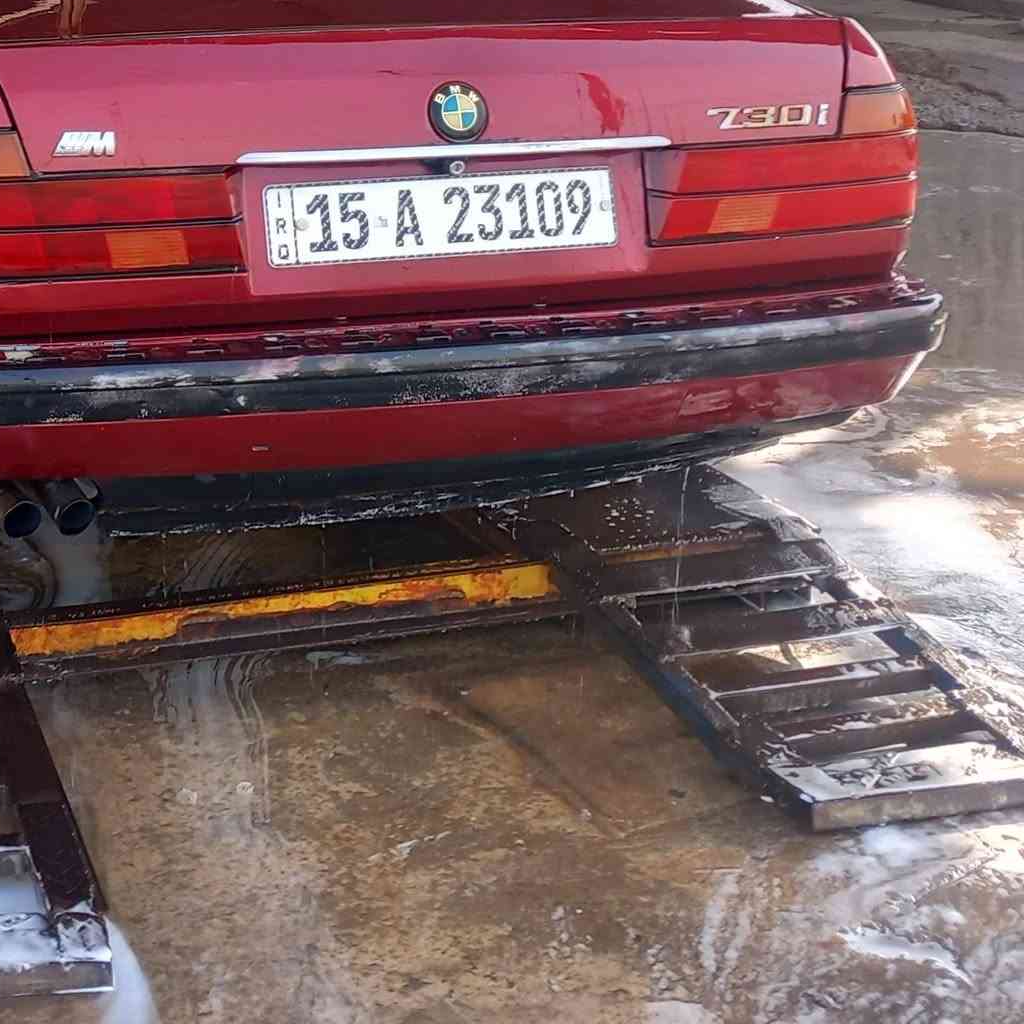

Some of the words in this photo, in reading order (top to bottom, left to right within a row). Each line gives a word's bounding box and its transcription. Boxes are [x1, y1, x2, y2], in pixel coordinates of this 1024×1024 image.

[707, 103, 830, 129] 730i
[275, 191, 290, 260] IRQ
[306, 191, 370, 252] 15
[394, 188, 424, 247] A
[442, 179, 593, 244] 23109
